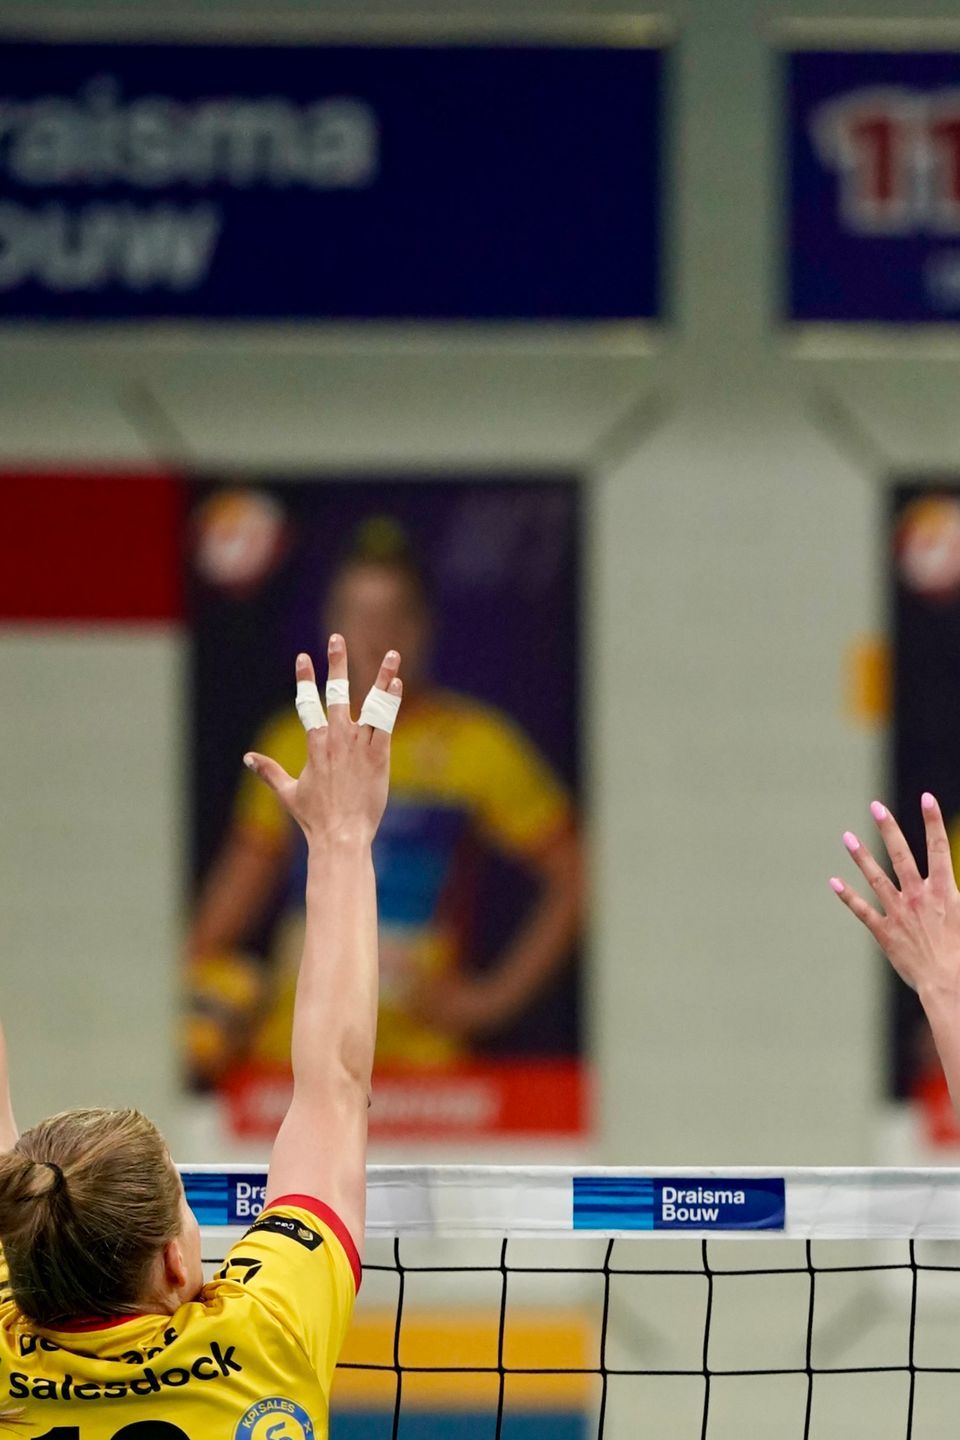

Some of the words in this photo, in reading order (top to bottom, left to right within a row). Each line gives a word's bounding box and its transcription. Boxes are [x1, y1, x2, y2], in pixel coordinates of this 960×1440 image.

[662, 1186, 745, 1204] Draisma
[662, 1205, 719, 1221] Bouw
[9, 1341, 243, 1400] salesdock
[242, 1408, 260, 1428] KPI
[258, 1399, 296, 1413] SALES
